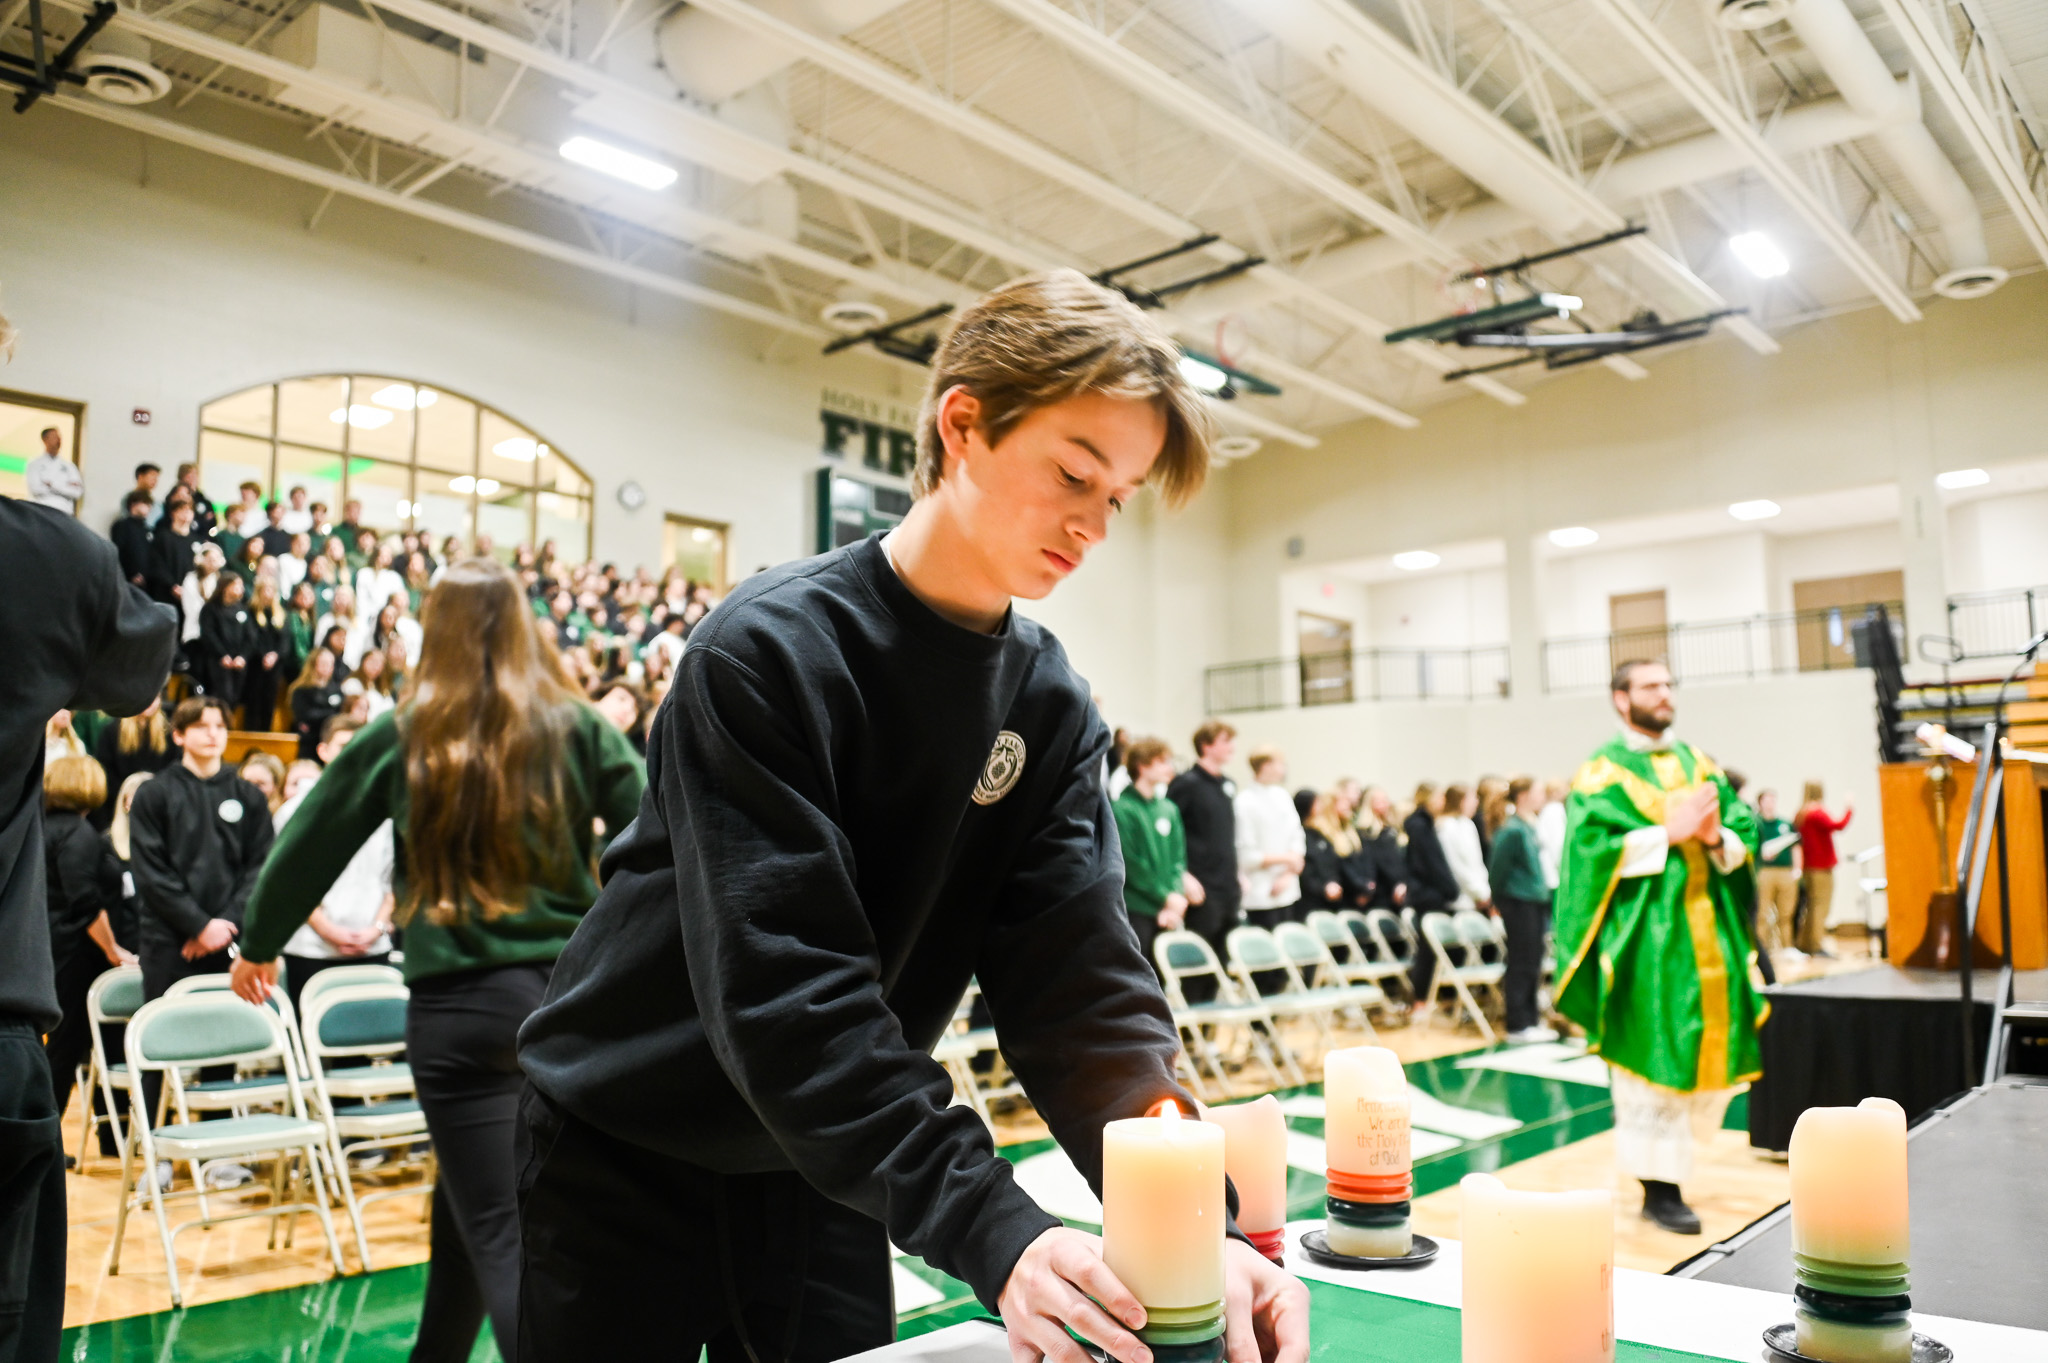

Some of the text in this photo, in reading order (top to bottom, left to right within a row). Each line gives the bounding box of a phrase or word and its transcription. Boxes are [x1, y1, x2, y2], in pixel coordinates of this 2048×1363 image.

[821, 387, 880, 416] HOLY
[1369, 1116, 1384, 1131] We
[1357, 1132, 1373, 1149] the
[1370, 1151, 1379, 1167] of
